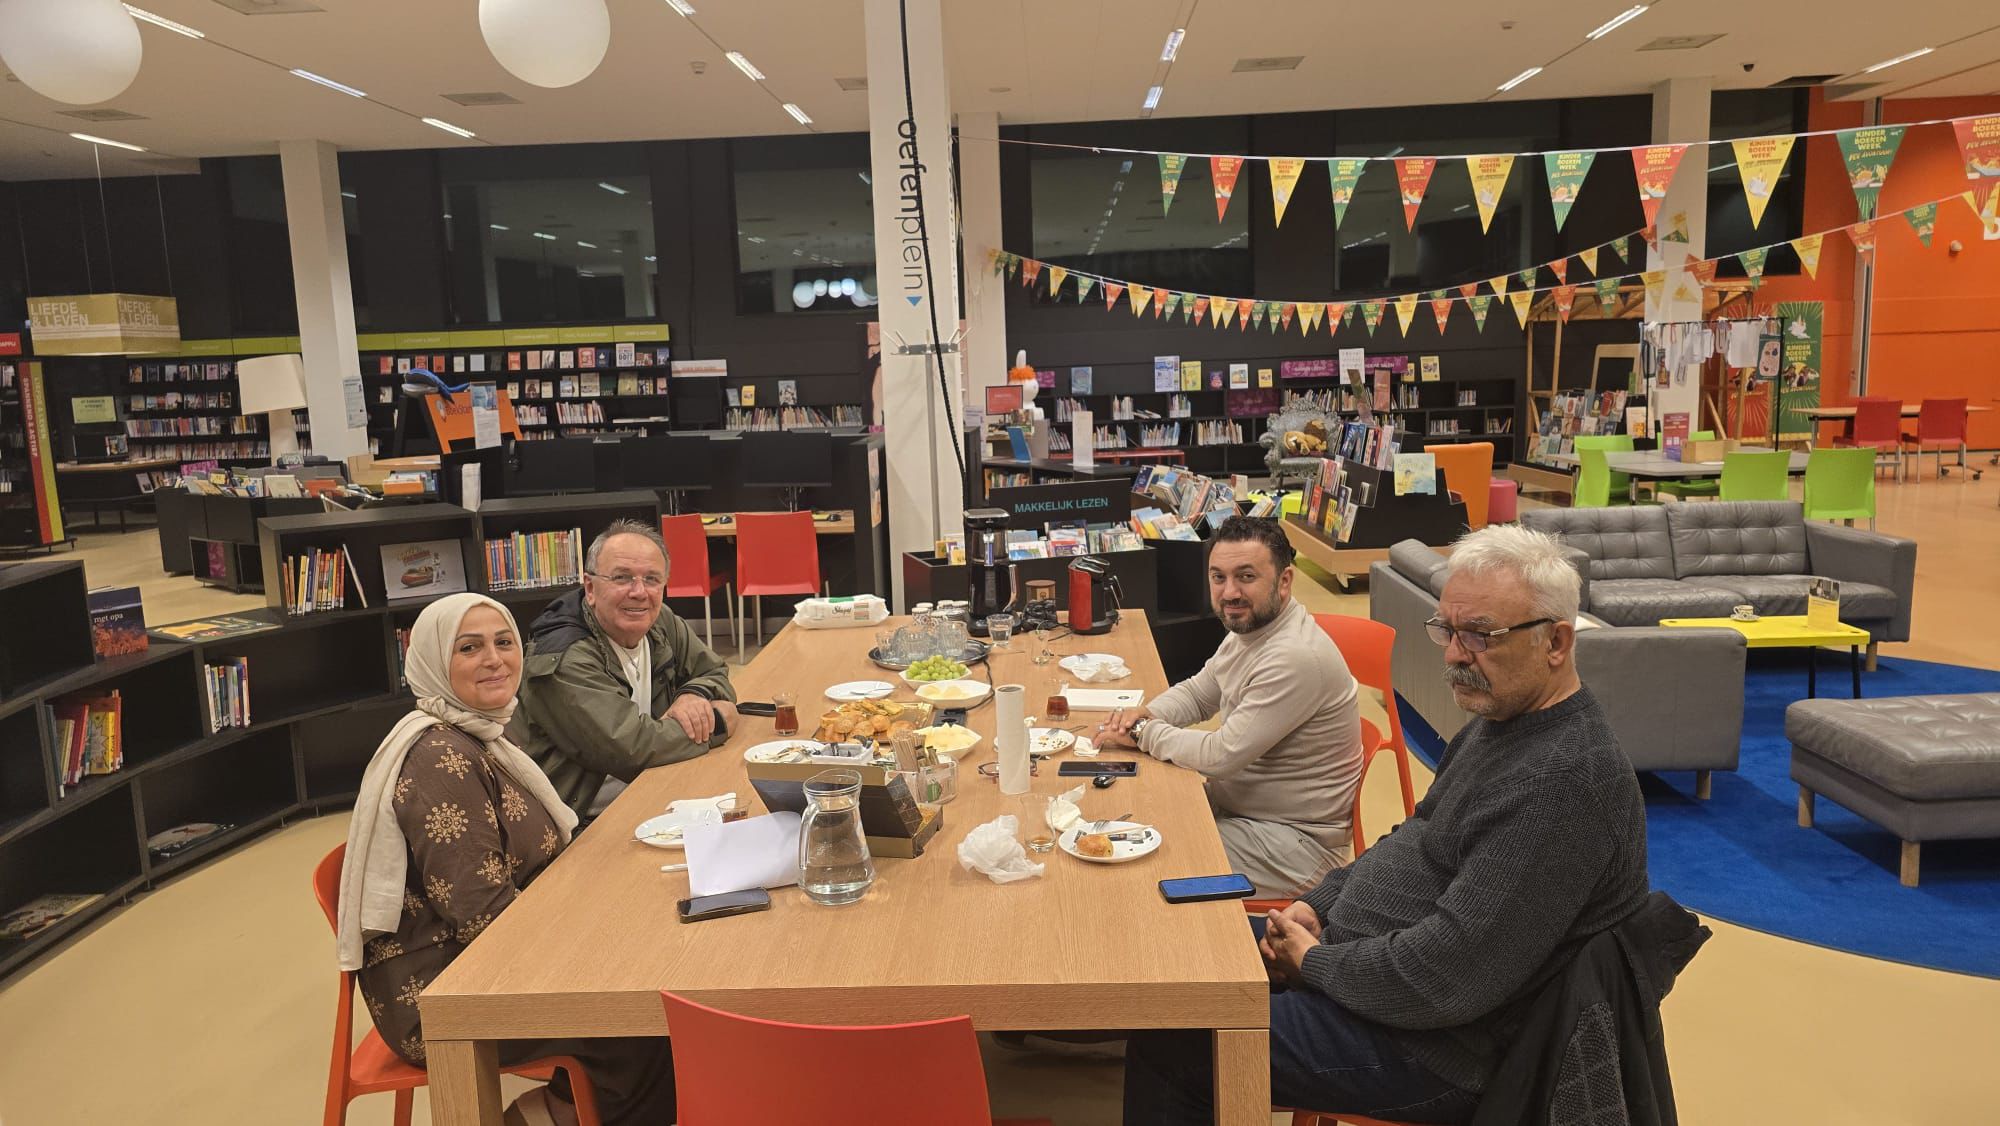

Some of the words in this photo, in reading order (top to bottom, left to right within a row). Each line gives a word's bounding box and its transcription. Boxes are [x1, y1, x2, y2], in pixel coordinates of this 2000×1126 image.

[1854, 136, 1887, 144] BOEKEN
[1856, 129, 1885, 137] KINDER
[894, 119, 929, 290] oefenplein
[30, 302, 78, 316] LIEFDE
[119, 300, 153, 314] LIEFDE
[31, 316, 41, 329] &
[45, 314, 89, 328] LEVEN
[129, 314, 160, 326] LEVEN
[1014, 500, 1074, 513] MAKKELIJK
[1076, 497, 1109, 509] LEZEN
[94, 615, 109, 624] met
[110, 613, 124, 622] opa
